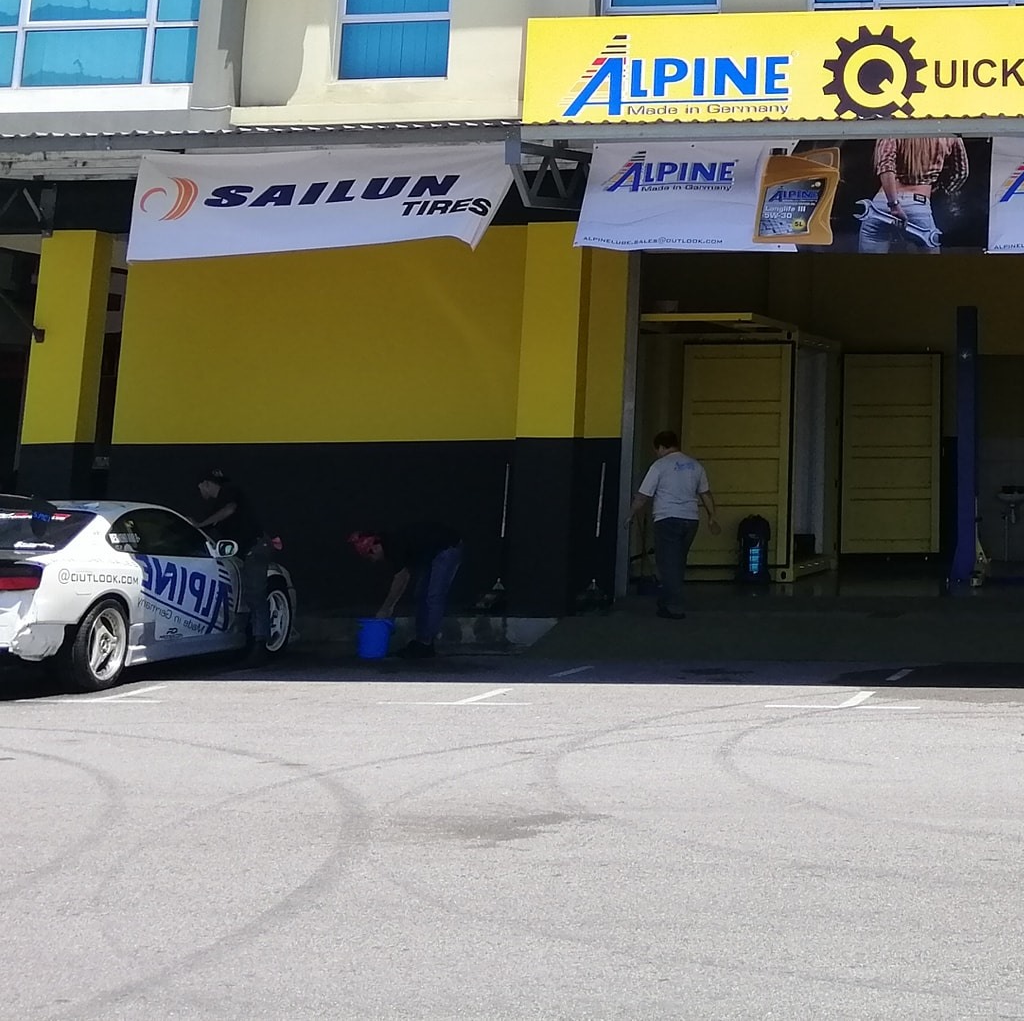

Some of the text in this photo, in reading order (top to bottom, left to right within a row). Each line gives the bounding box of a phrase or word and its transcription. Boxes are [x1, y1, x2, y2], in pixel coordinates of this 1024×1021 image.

[562, 54, 790, 116] ALPINE
[628, 103, 789, 115] Made in Germany
[604, 162, 735, 192] ALPINE
[641, 184, 669, 192] Made
[685, 184, 733, 192] Germany
[204, 175, 460, 207] SAILUN
[402, 198, 492, 217] TIRES
